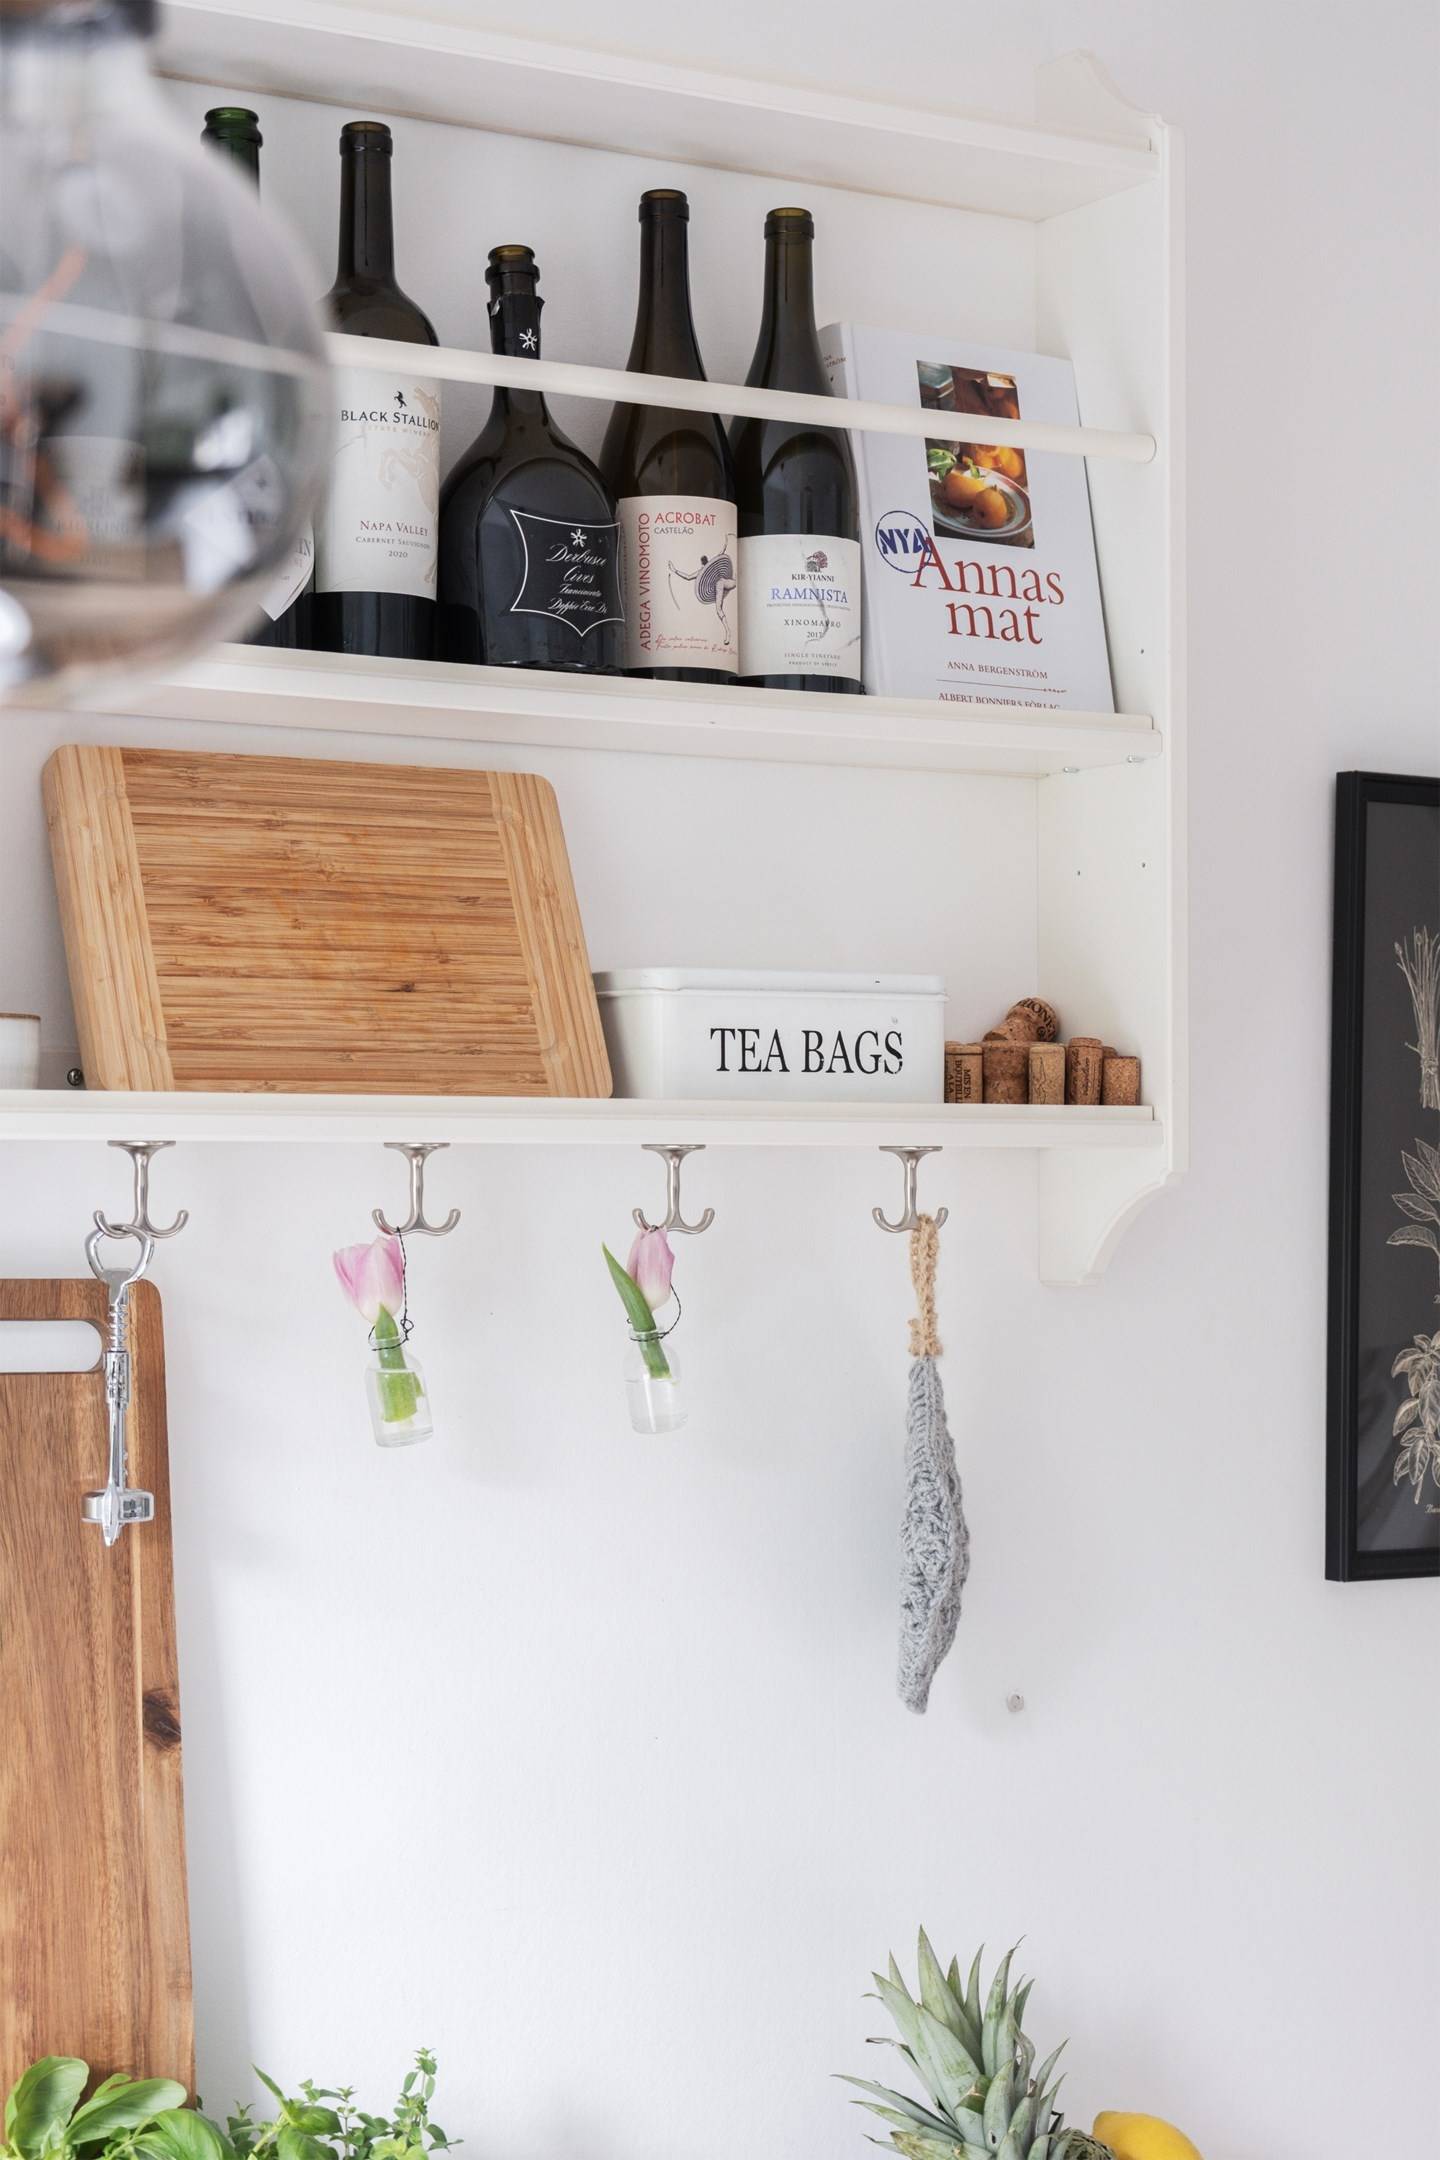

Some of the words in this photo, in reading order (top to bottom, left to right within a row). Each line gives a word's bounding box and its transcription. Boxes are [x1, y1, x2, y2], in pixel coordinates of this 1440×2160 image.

[341, 409, 388, 422] BLACK
[393, 411, 439, 432] STALLION
[360, 520, 392, 532] NAPA
[396, 521, 429, 536] VALLEY
[654, 512, 717, 526] ACROBAT
[654, 526, 694, 535] CASTELÃO
[355, 536, 395, 545] CABERNET
[878, 528, 932, 554] NYA
[388, 550, 408, 558] 2020
[638, 513, 651, 596] VINOMOTO
[910, 536, 1065, 606] Annas
[771, 588, 848, 603] RAMNISTA
[639, 600, 652, 651] ADEGA
[945, 601, 1043, 644] mat
[947, 661, 975, 672] ANNA
[978, 664, 1048, 679] BERGENSTRÖM
[938, 692, 973, 703] ALBERT
[710, 1028, 790, 1072] TEA
[801, 1030, 903, 1074] BAGS
[955, 1060, 963, 1103] BOUTEILL
[964, 1086, 971, 1098] EN
